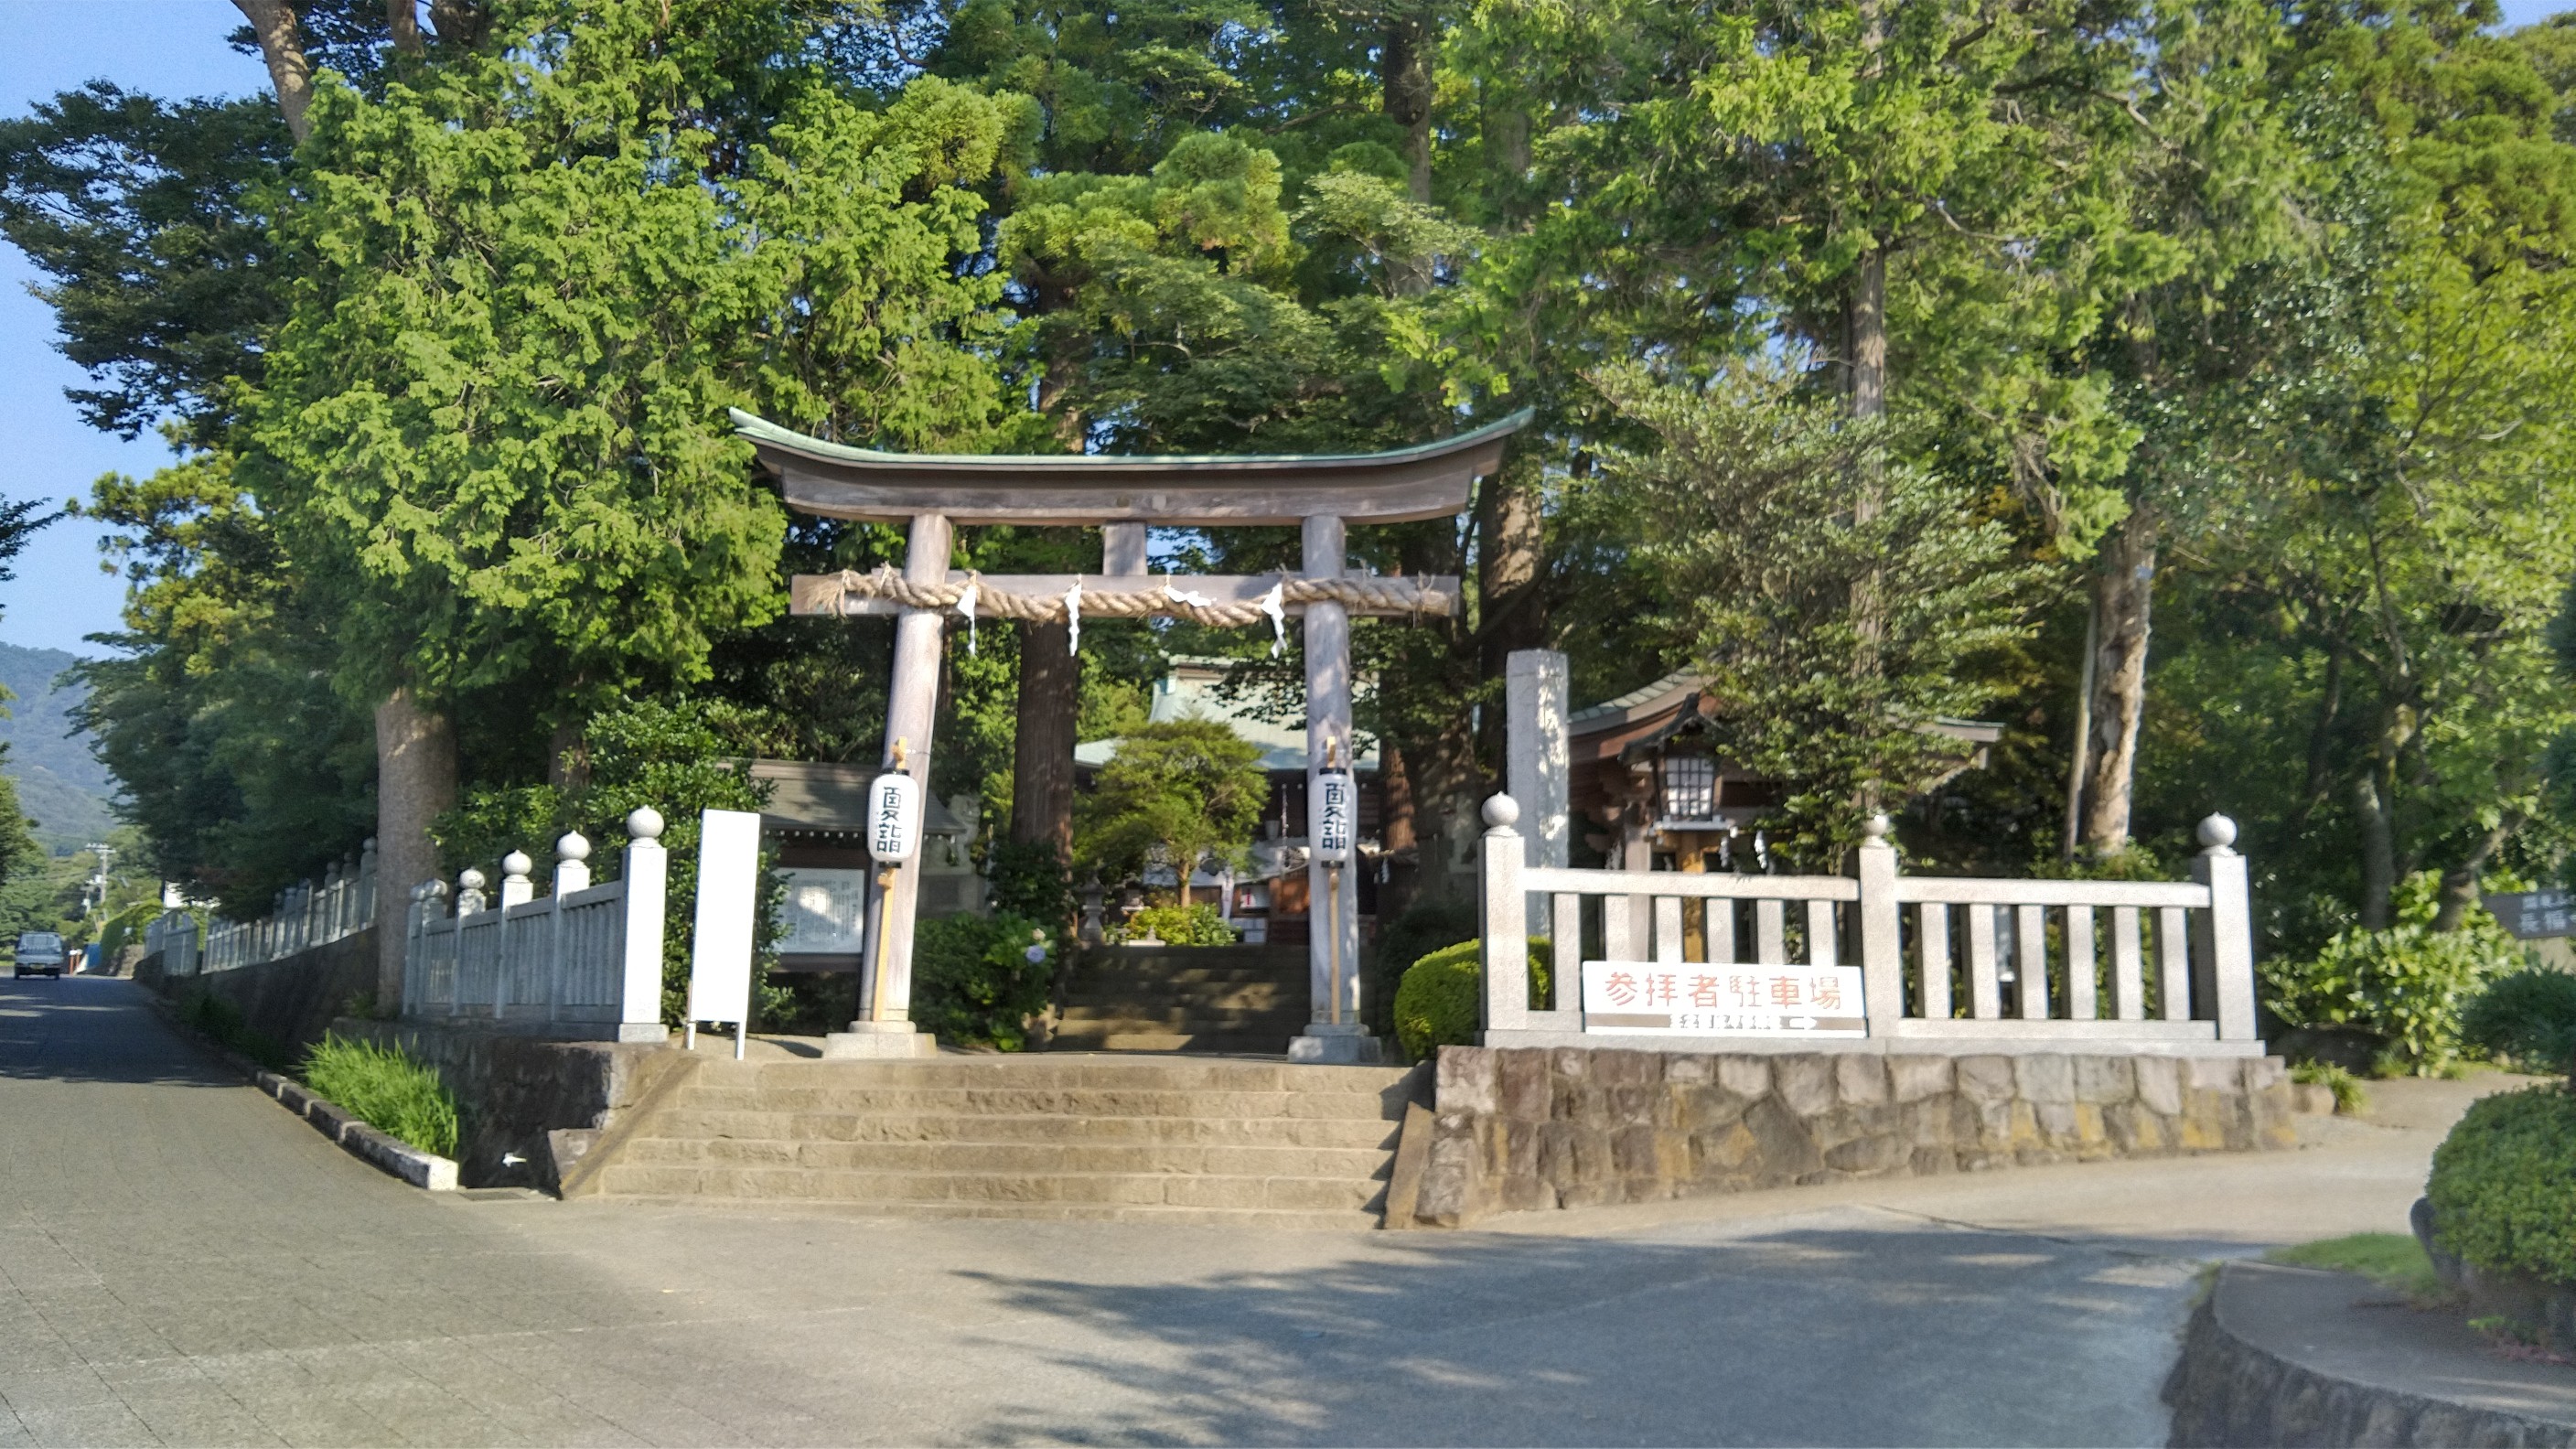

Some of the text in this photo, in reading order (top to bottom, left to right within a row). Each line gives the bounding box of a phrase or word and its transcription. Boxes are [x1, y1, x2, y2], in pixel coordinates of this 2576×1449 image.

[877, 786, 903, 853] 夏詣
[1323, 782, 1347, 850] 夏詣
[1605, 971, 1841, 1010] 参拝者駐車場
